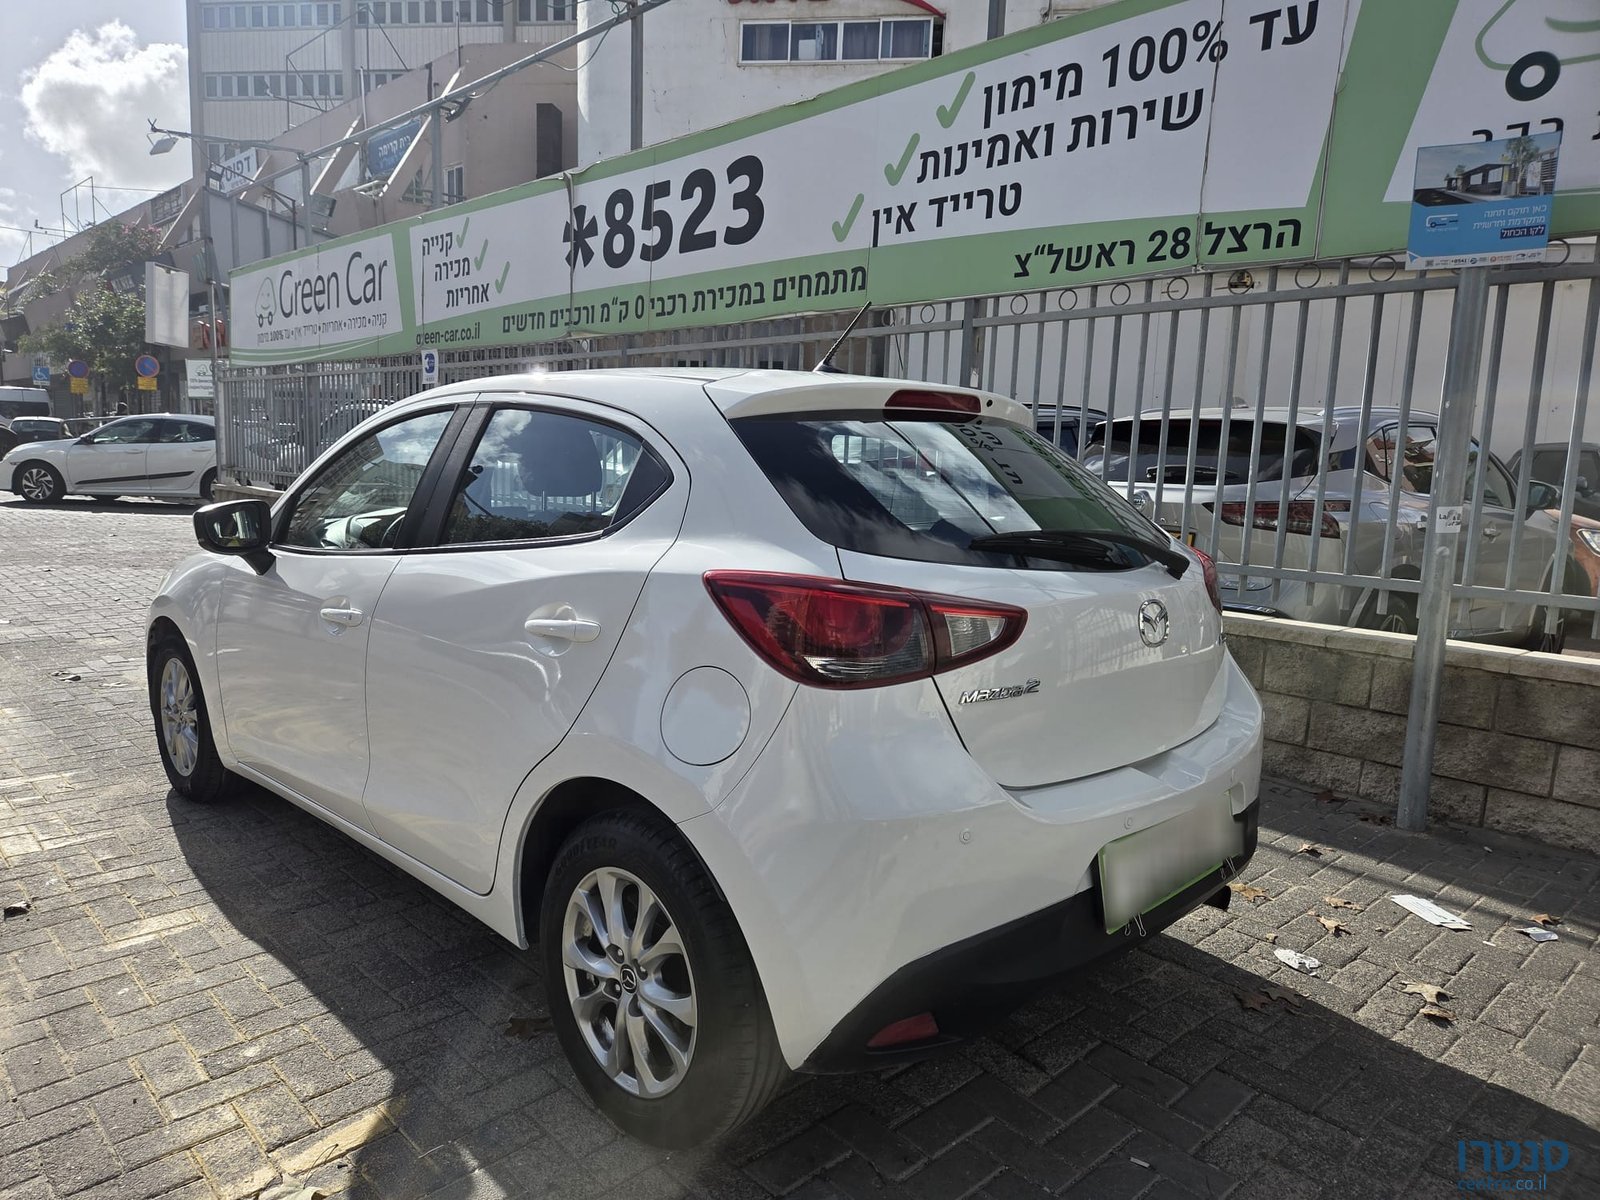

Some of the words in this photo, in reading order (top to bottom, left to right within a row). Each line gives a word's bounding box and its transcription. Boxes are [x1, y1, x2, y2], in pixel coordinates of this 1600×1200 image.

[1249, 0, 1319, 51] עד
[1102, 20, 1229, 89] 100%
[983, 62, 1083, 129] מימון
[1066, 88, 1204, 153] שירות
[916, 122, 1055, 184] ואמינות
[928, 182, 1022, 228] טרייד
[1532, 204, 1547, 214] כאן
[872, 202, 918, 248] אין
[1204, 218, 1302, 256] הרצל
[1501, 228, 1527, 238] הכחול
[422, 232, 453, 257] קנייה
[1146, 226, 1192, 263] 28
[279, 269, 340, 319] Green
[346, 251, 388, 306] Car
[434, 256, 471, 282] מכירה
[772, 265, 867, 302] מתמחים
[445, 283, 490, 308] אחריות
[634, 294, 645, 320] 0
[650, 293, 687, 318] רכבי
[692, 281, 765, 313] במכירת
[502, 311, 545, 333] חדשים
[550, 304, 595, 328] ורכבים
